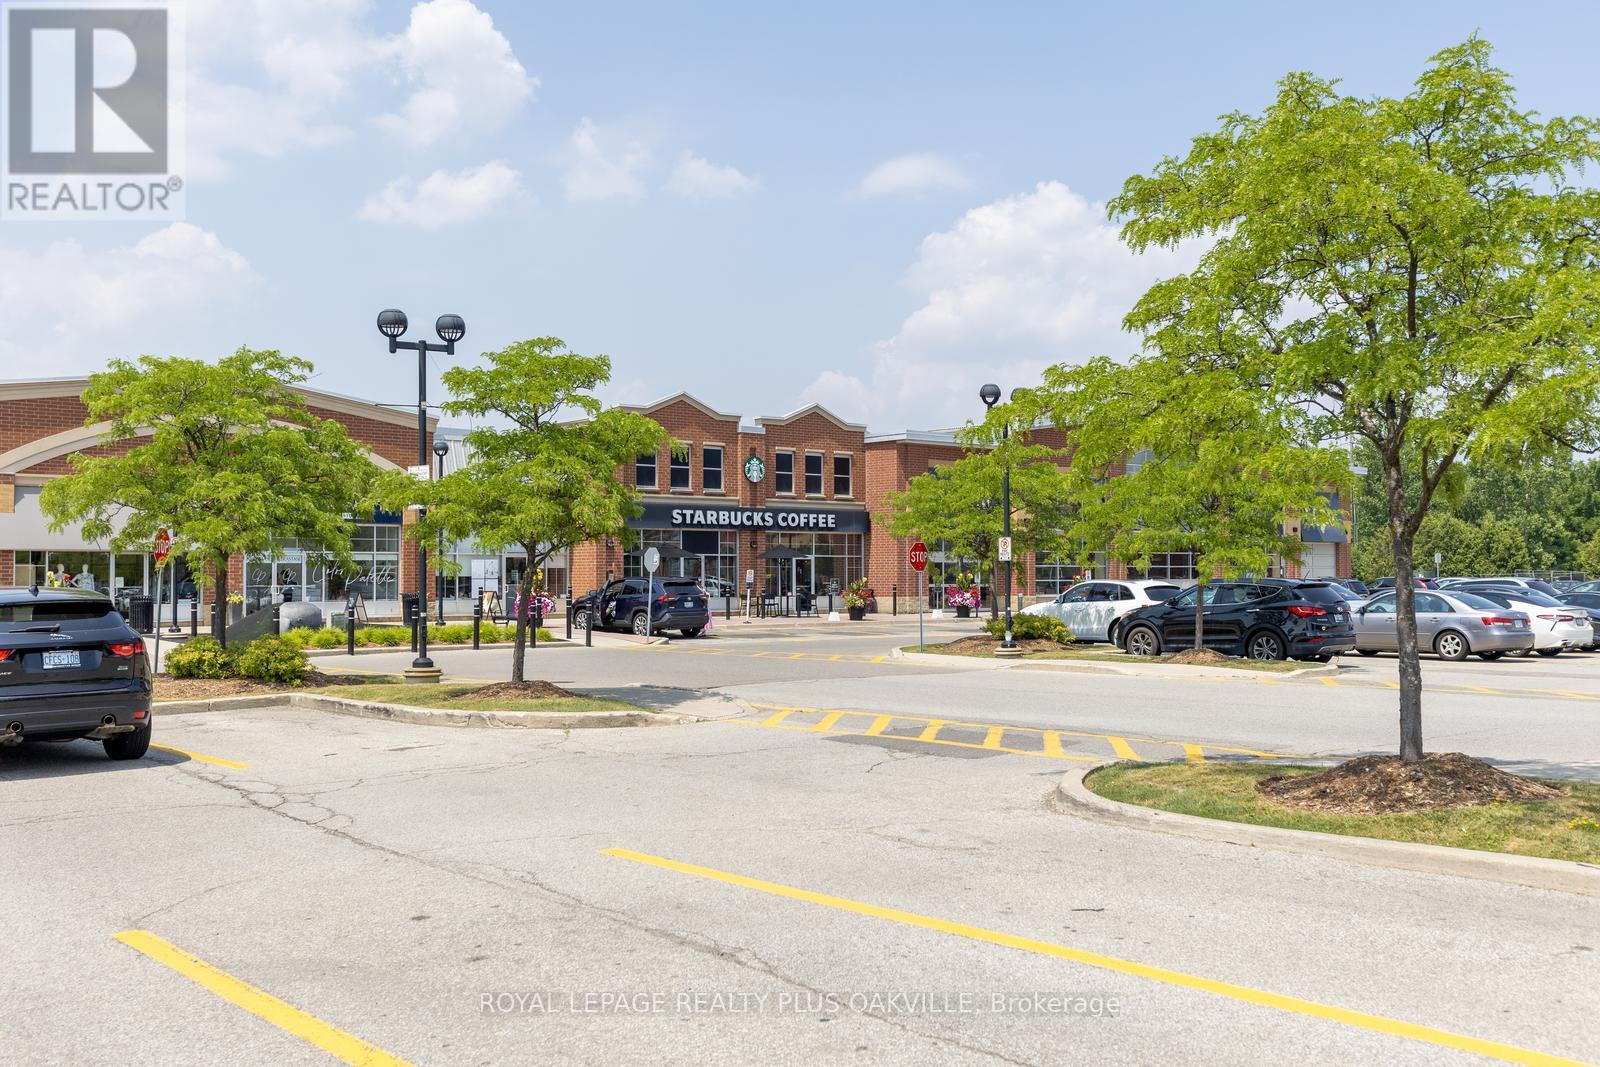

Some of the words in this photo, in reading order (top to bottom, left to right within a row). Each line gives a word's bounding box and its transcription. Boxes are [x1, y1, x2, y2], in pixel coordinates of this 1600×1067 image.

[672, 509, 774, 527] STARBUCKS
[777, 512, 836, 528] COFFEE
[910, 551, 928, 563] STOP
